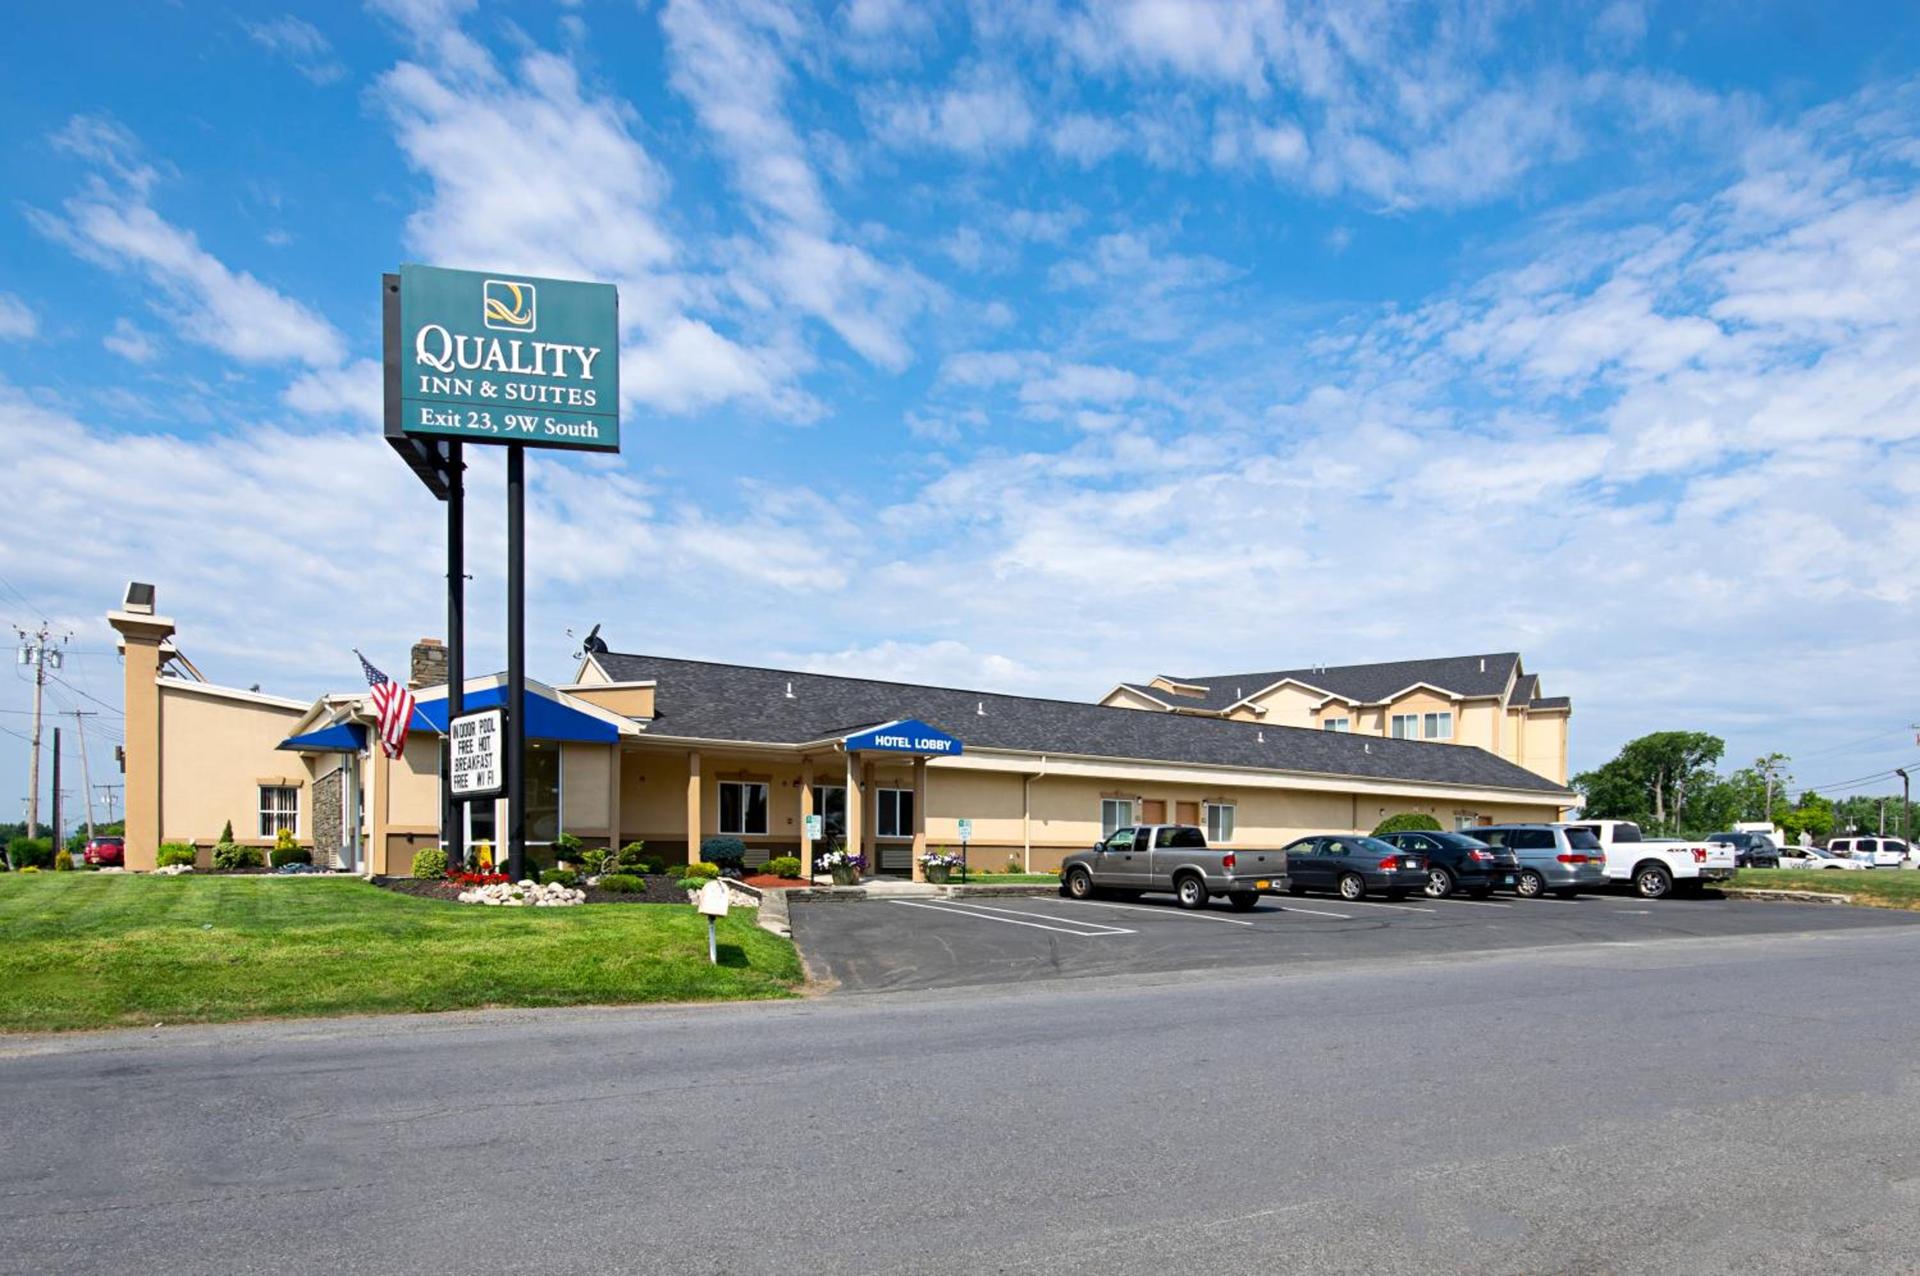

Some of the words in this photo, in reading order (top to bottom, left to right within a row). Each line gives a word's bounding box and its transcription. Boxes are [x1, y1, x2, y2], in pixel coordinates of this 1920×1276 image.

[416, 324, 600, 379] QUALITY
[419, 376, 473, 396] INN
[480, 381, 498, 397] &
[505, 383, 597, 407] SUITES
[420, 408, 461, 427] Exit
[467, 411, 498, 433] 23,
[504, 415, 539, 433] 9W
[544, 417, 599, 438] South
[479, 718, 495, 735] POOL
[458, 739, 474, 755] FREE
[478, 736, 491, 752] HOT
[875, 735, 912, 748] HOTEL
[914, 738, 952, 751] LOBBY
[455, 753, 493, 772] BREAKFAST
[453, 773, 469, 789] FREE
